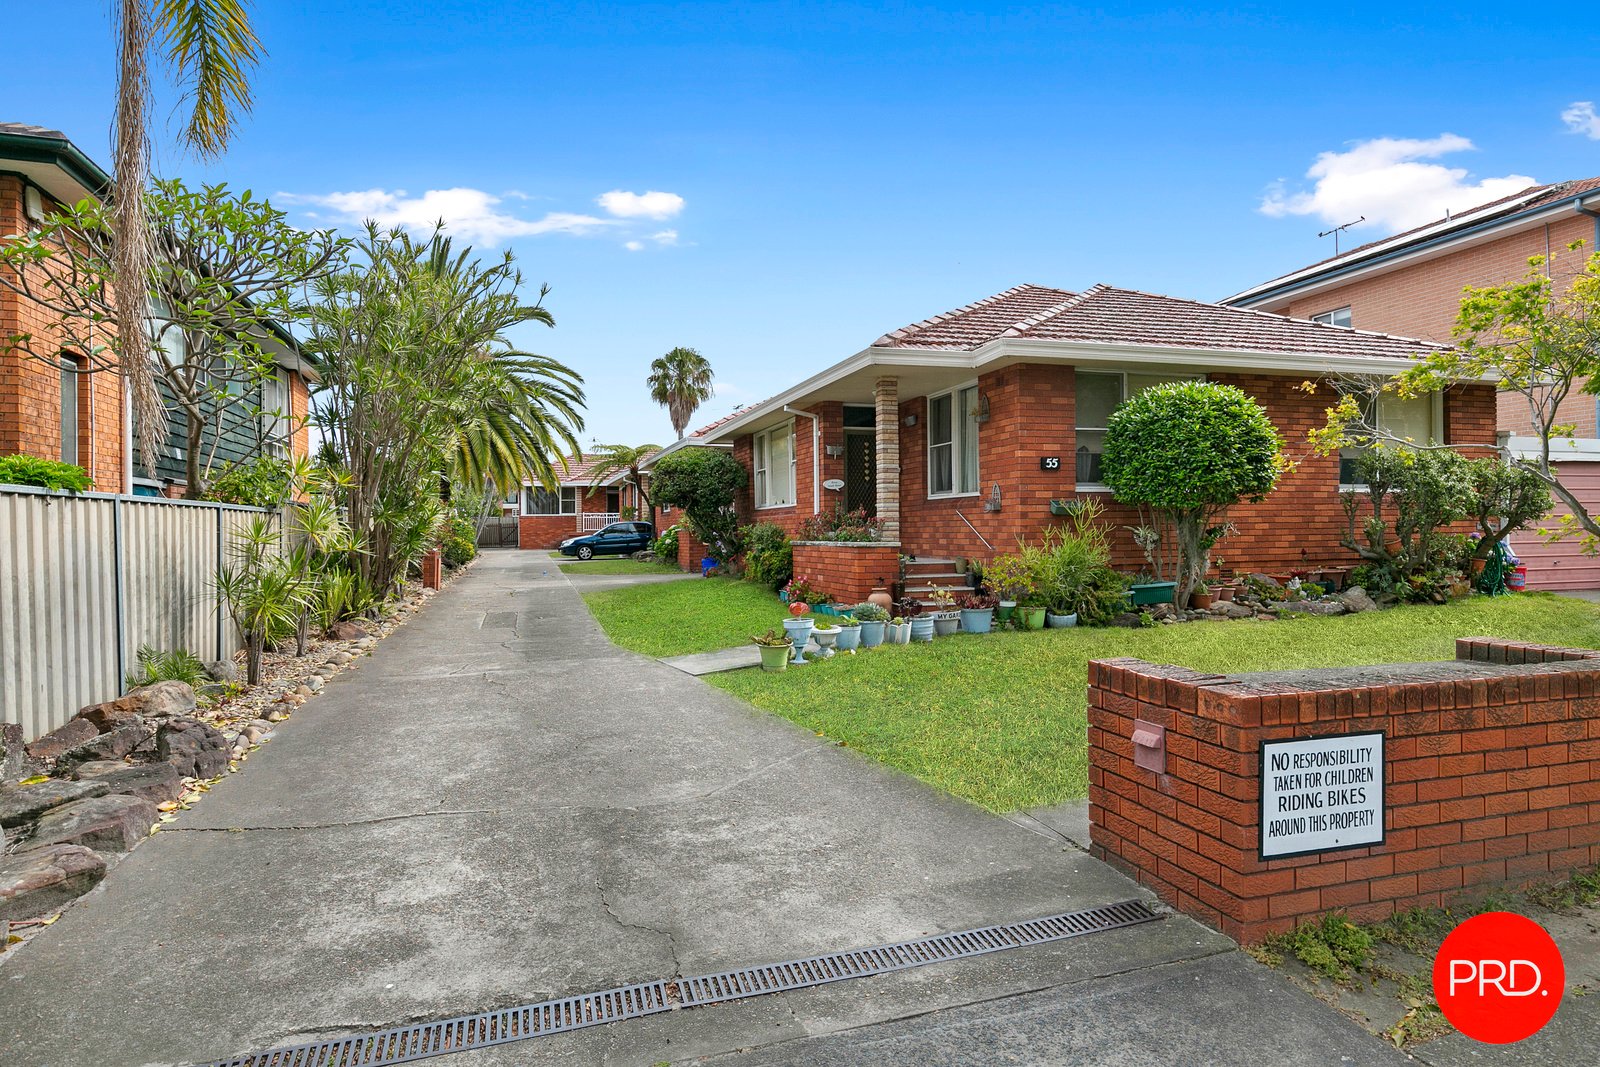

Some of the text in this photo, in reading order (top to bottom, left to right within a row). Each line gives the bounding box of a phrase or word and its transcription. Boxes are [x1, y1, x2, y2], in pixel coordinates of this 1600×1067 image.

[1045, 457, 1059, 468] 55
[1271, 747, 1373, 771] NO RESPONSIBILITY
[1273, 767, 1374, 792] TAKEN FOR CHILDREN
[1278, 787, 1366, 813] RIDING BIKES
[1268, 809, 1375, 838] AROUND THIS PROPERTY
